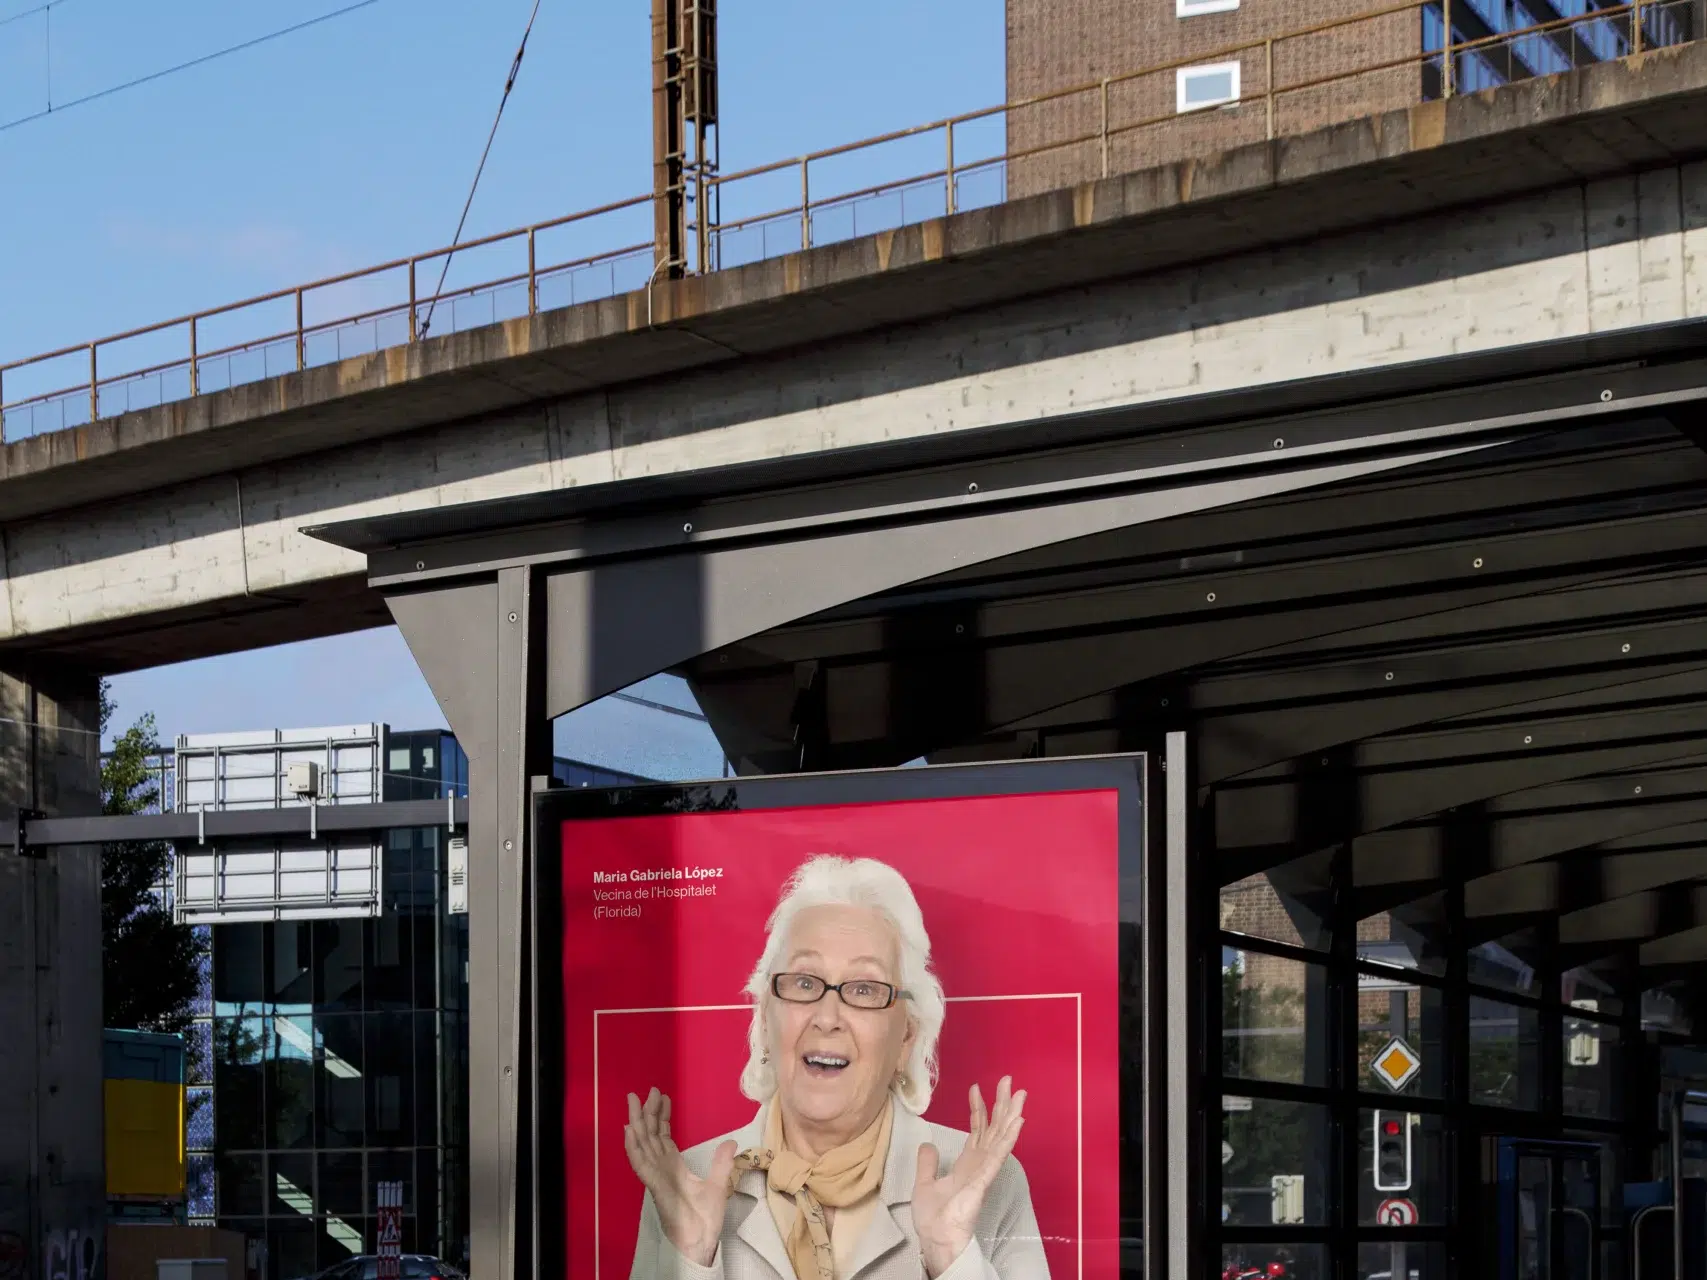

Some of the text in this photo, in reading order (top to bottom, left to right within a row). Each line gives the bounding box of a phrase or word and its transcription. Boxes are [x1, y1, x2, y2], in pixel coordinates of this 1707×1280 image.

[593, 866, 723, 883] Maria Gabriela López
[593, 884, 717, 901] Vecina de l'Hospitalet
[593, 904, 642, 919] (Florida)
